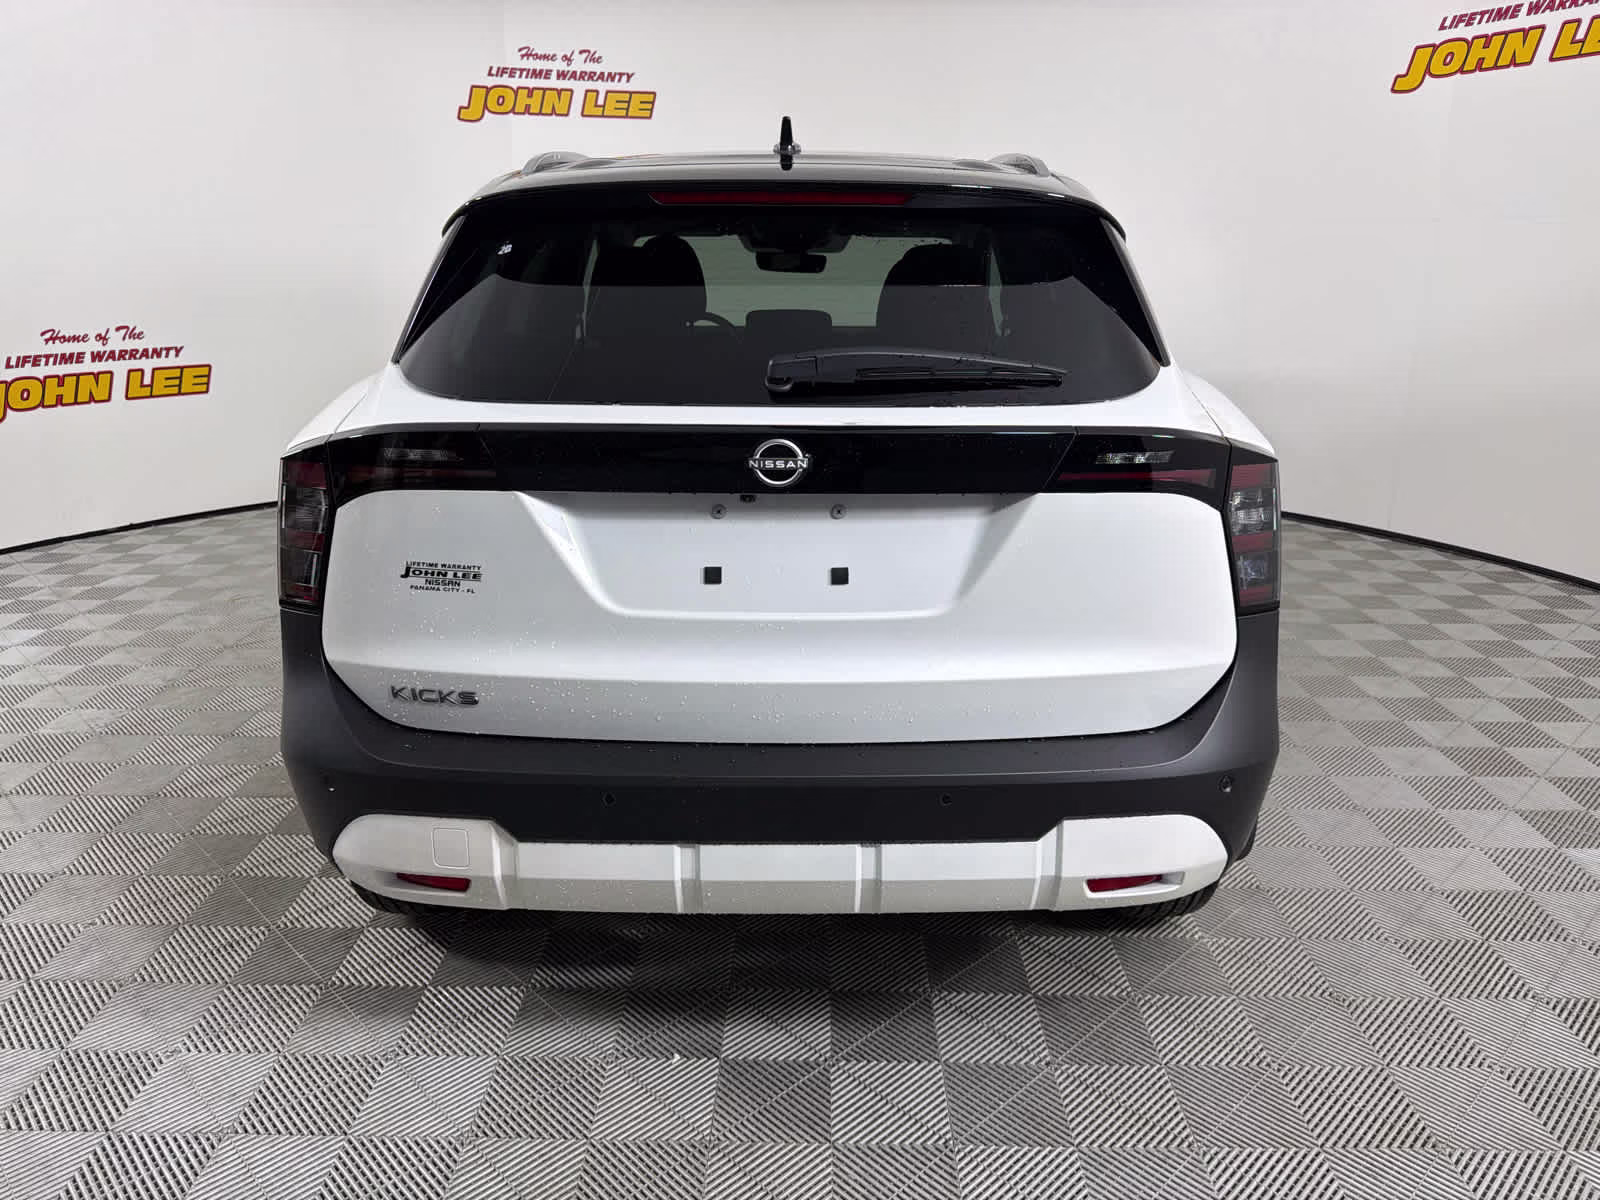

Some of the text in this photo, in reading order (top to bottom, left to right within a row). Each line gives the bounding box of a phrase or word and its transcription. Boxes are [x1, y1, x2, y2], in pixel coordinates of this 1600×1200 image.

[1438, 3, 1523, 31] LIFETIME
[518, 46, 603, 66] Home of The
[1390, 24, 1546, 94] JOHN
[487, 66, 635, 83] LIFETIME WARRANTY
[457, 85, 657, 123] JOHN LEE
[40, 325, 145, 346] Home of The
[5, 346, 184, 369] LIFETIME WARRANTY
[0, 364, 212, 424] OHN LEE
[748, 459, 809, 469] NISSAN
[400, 566, 482, 580] JOHN LEE
[425, 579, 461, 587] NISSAN
[391, 685, 479, 705] KICKS
